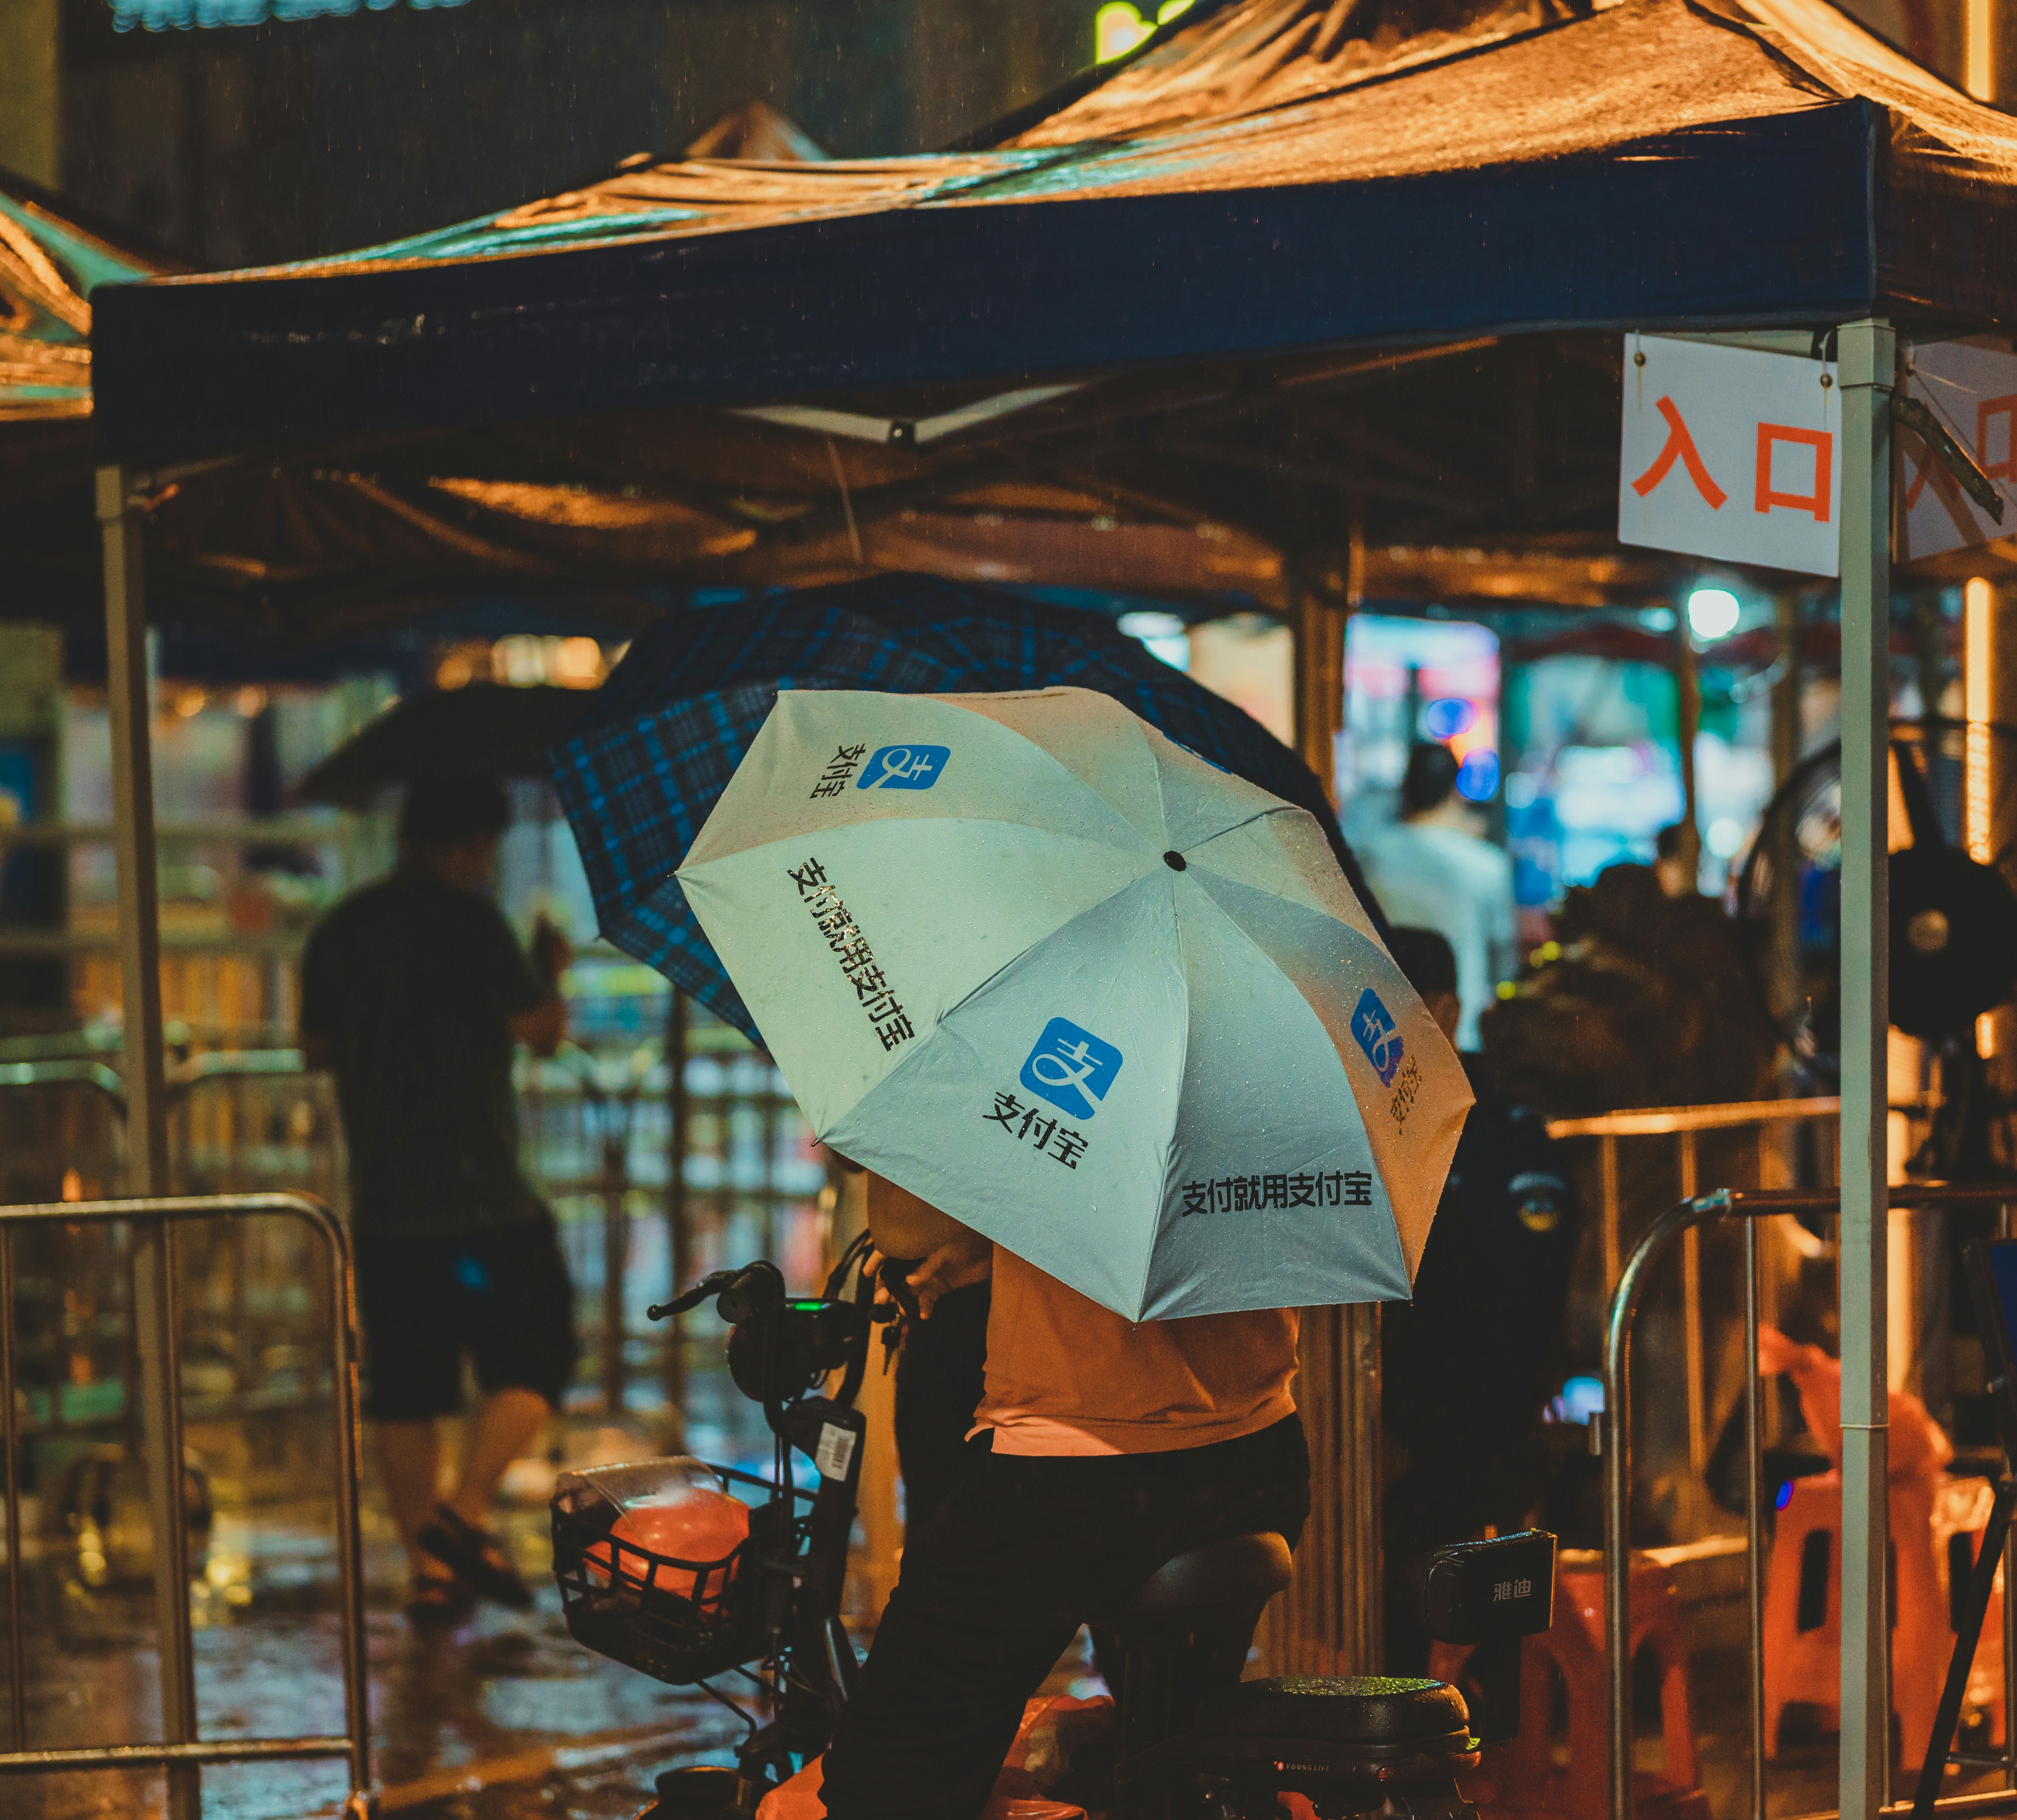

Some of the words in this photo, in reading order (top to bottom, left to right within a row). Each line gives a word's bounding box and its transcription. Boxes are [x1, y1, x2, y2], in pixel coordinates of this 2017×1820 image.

[1632, 395, 1833, 523] 入口
[810, 743, 866, 798] 支付宝
[787, 857, 915, 1052] 支付就用支付宝
[983, 1092, 1089, 1170] 支付宝
[1182, 1171, 1372, 1217] 支付就用支付宝
[1493, 1578, 1531, 1602] 雅迪
